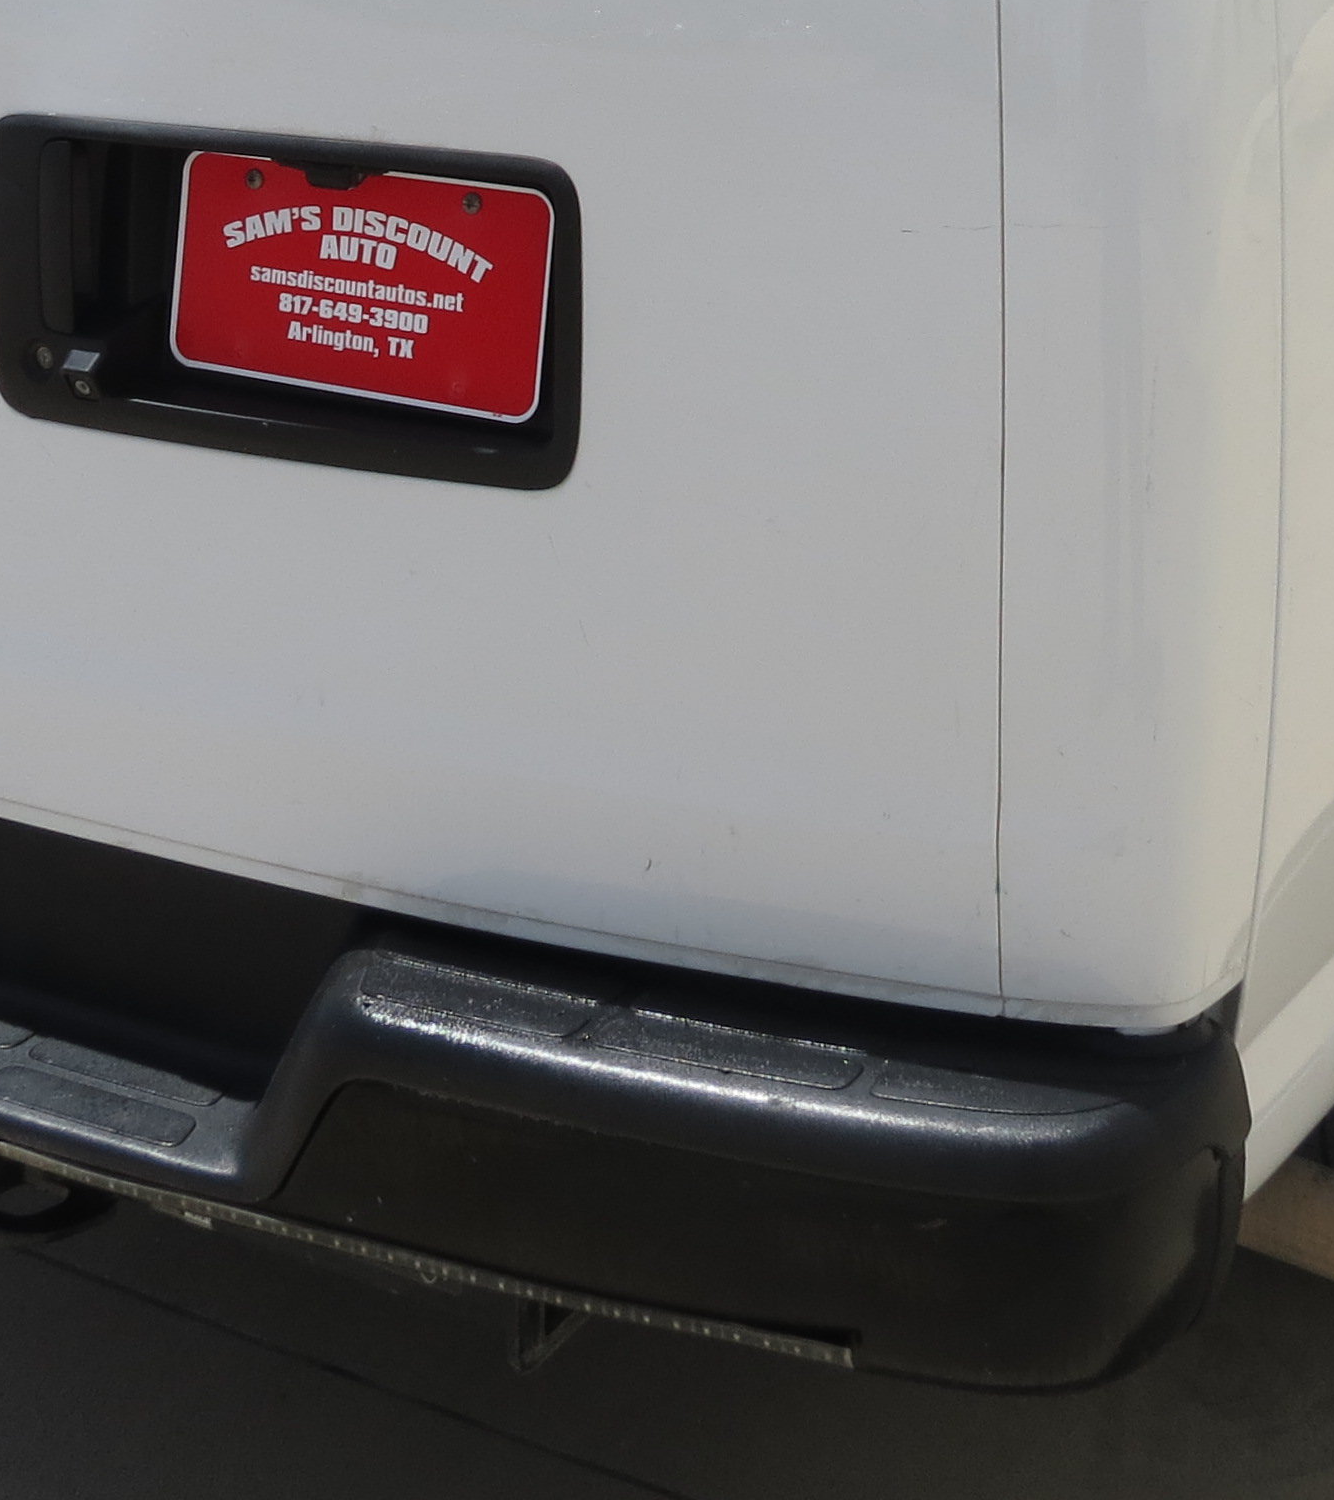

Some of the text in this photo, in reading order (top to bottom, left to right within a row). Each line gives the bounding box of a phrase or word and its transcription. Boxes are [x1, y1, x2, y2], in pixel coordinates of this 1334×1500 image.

[223, 205, 493, 284] SAM'S DISCOUNT
[319, 234, 397, 271] AUTO
[250, 265, 464, 313] samsdiscountautos.net
[279, 293, 429, 334] 817-649-3900
[288, 321, 414, 360] Arlington, TX
